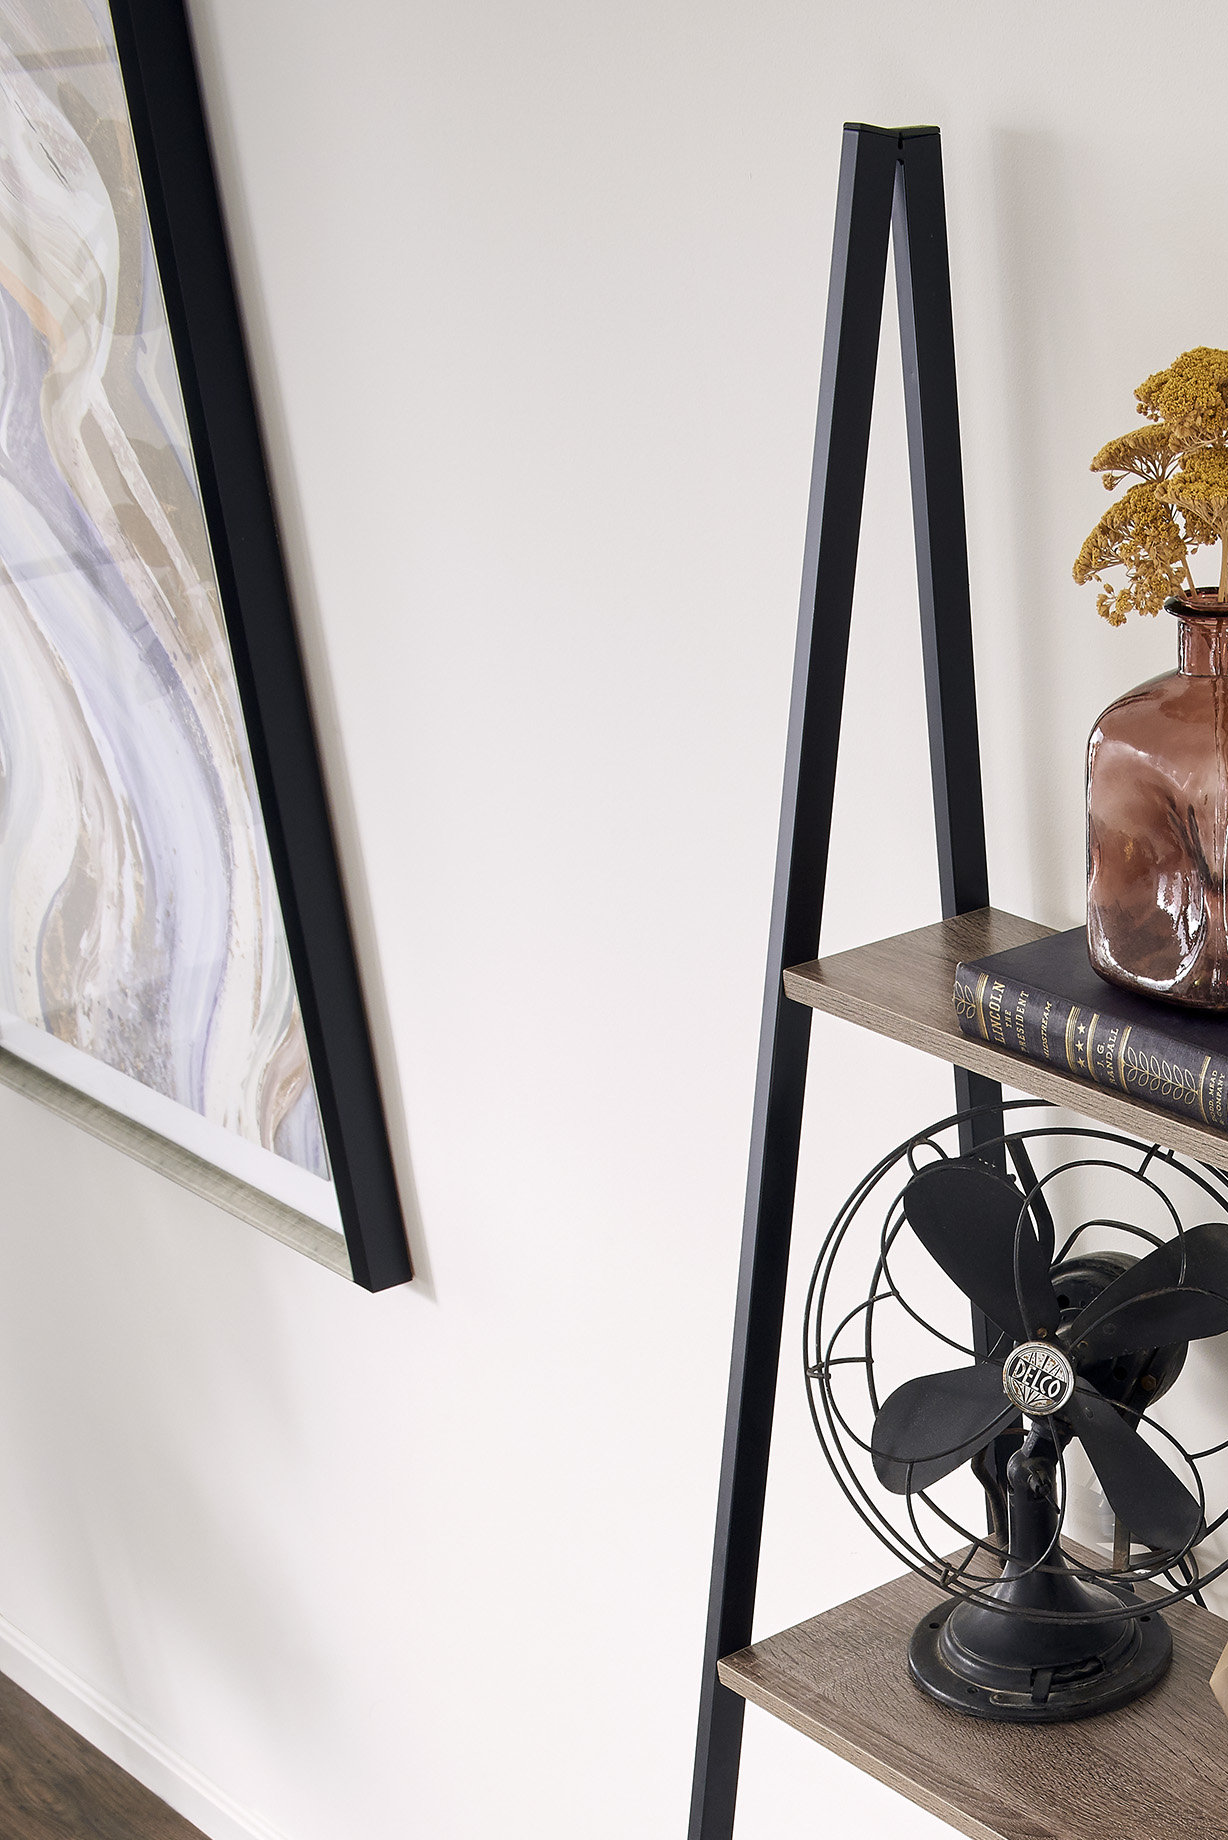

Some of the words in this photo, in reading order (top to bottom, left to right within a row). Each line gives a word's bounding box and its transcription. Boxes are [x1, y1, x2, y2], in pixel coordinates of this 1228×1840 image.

[988, 981, 1006, 1045] LINCOLN
[1004, 1009, 1012, 1028] THE
[1015, 990, 1030, 1053] PRESIDENT
[1039, 1001, 1053, 1059] MIDSTREAM
[1105, 1028, 1120, 1086] RANDALL
[1208, 1070, 1218, 1096] MEAD
[1215, 1073, 1227, 1117] COMPANY
[1012, 1358, 1061, 1398] DELCO
